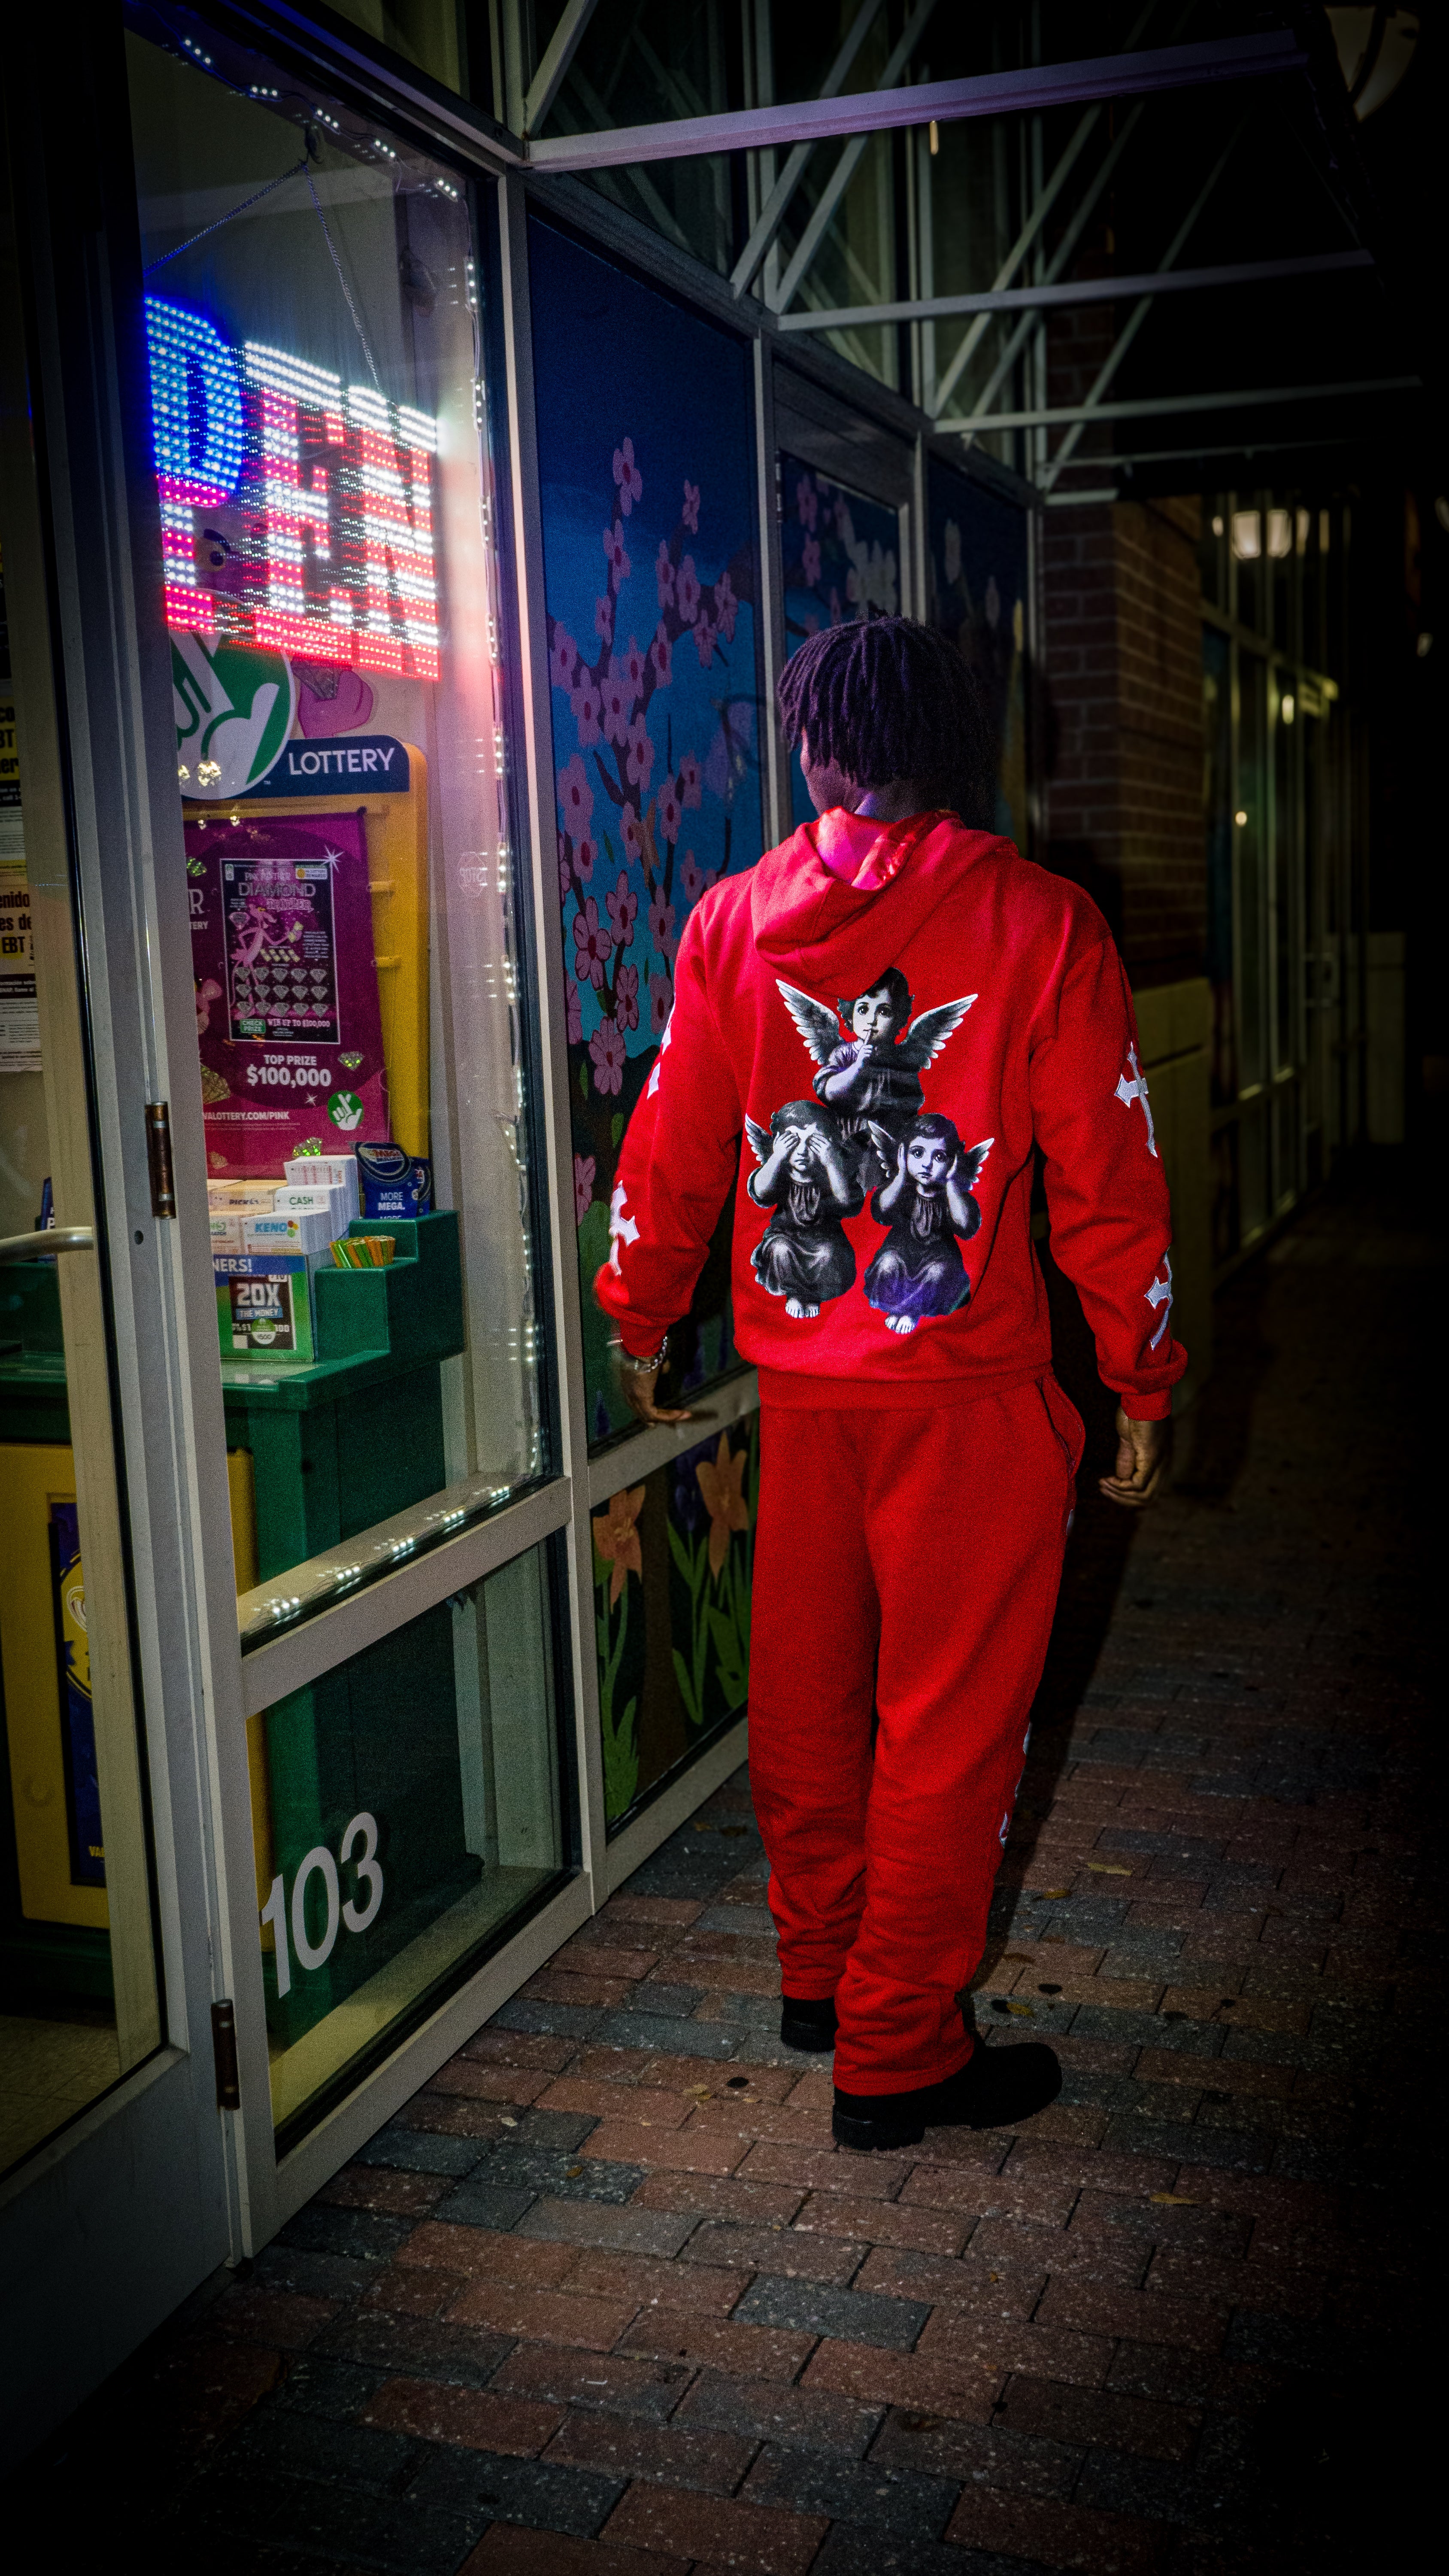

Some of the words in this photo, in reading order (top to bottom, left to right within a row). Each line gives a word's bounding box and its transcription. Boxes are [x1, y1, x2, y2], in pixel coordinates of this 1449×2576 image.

[144, 296, 439, 679] PEN
[289, 747, 395, 775] LOTTERY
[238, 882, 316, 897] DIAMOND
[2, 936, 25, 953] EBT
[263, 1054, 285, 1065] TOP
[286, 1055, 317, 1066] PRIZE
[246, 1064, 332, 1088] $100,000
[289, 1197, 314, 1205] CASH
[380, 1192, 403, 1201] MORE
[255, 1222, 287, 1233] KENO
[236, 1282, 281, 1306] 20X
[261, 1812, 383, 1999] 103
